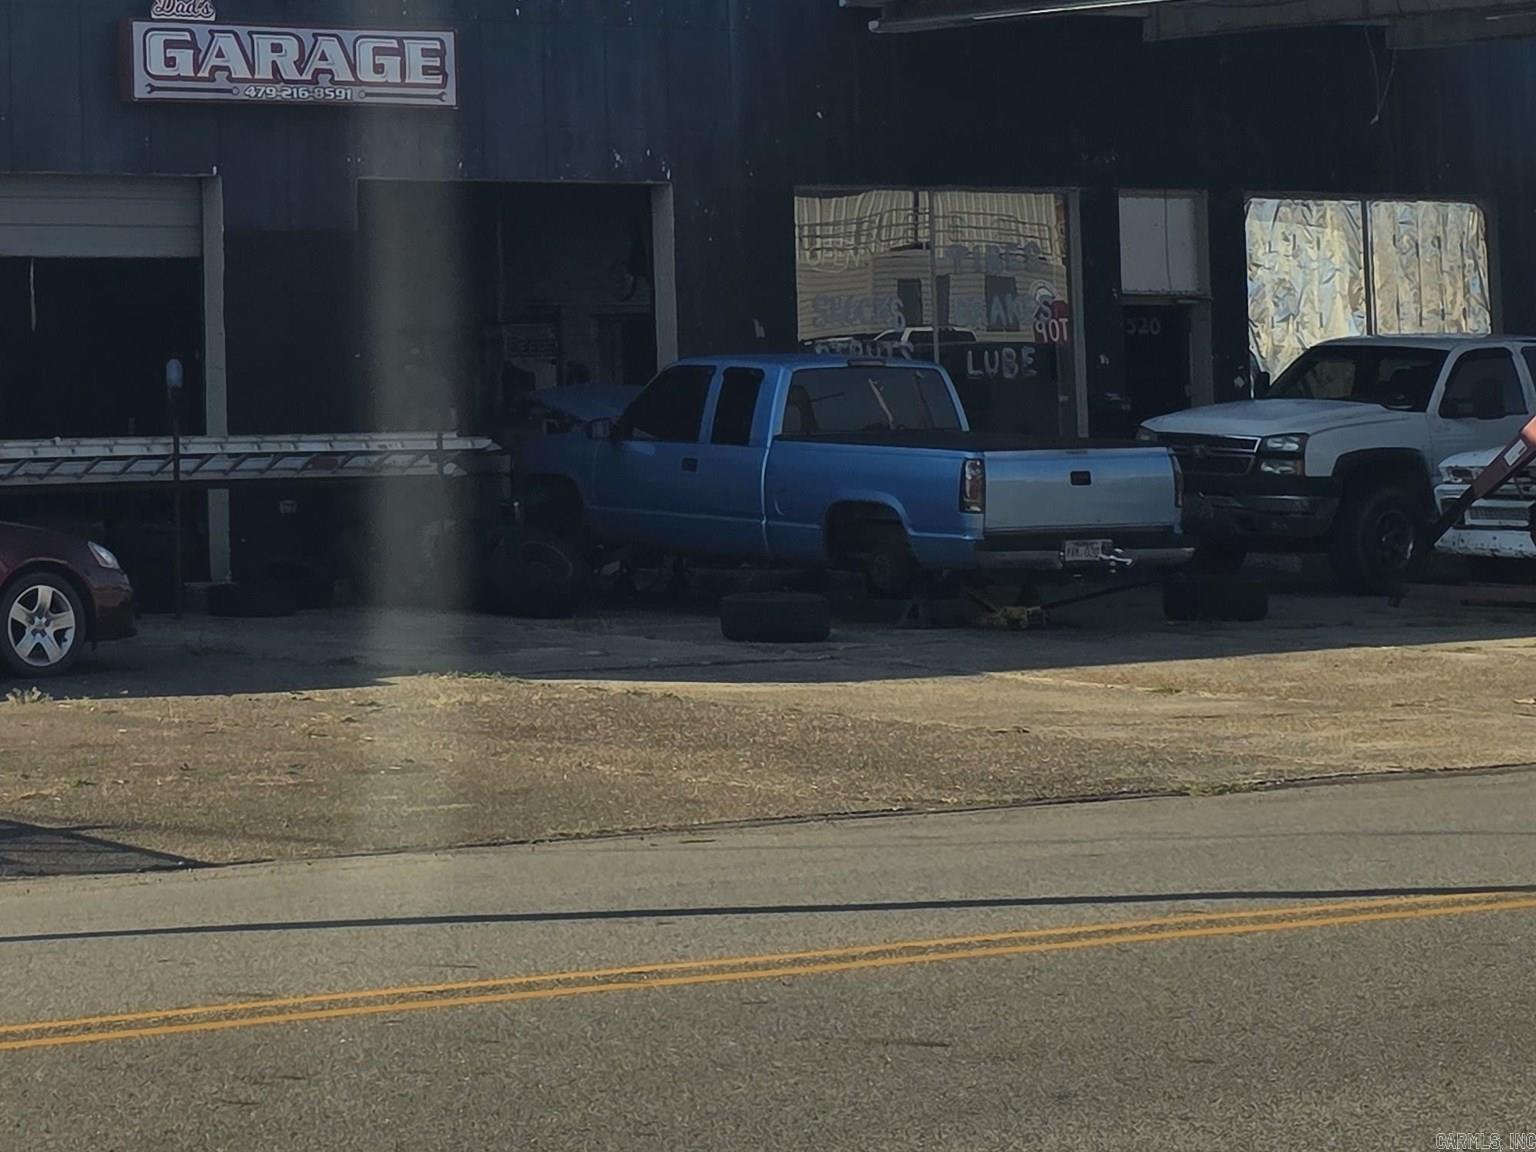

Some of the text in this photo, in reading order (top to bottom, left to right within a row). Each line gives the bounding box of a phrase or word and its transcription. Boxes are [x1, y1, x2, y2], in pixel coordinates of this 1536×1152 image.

[144, 28, 448, 86] GARAGE
[244, 85, 353, 101] 479-216-8591
[966, 346, 1038, 379] LUBE
